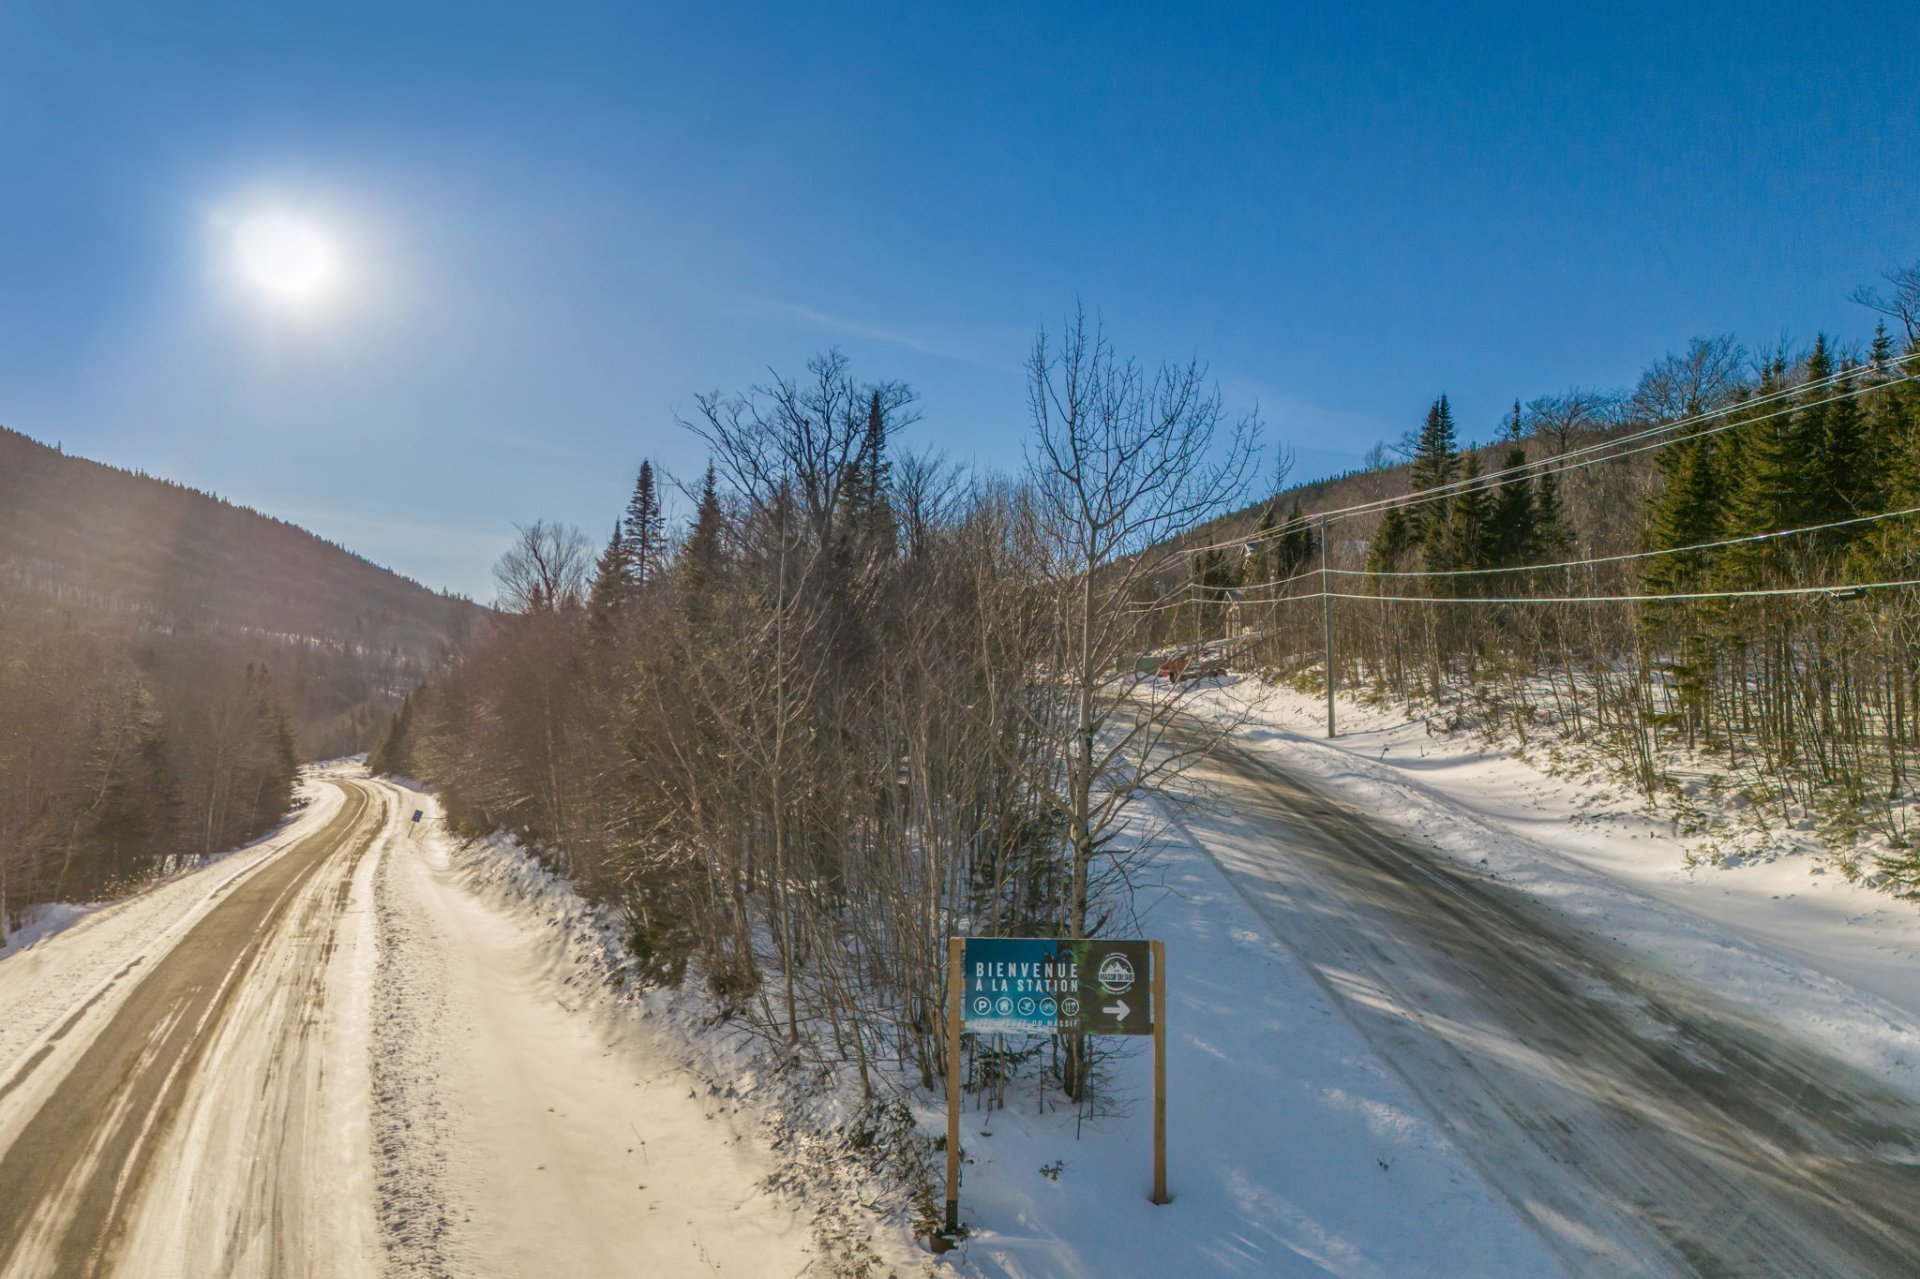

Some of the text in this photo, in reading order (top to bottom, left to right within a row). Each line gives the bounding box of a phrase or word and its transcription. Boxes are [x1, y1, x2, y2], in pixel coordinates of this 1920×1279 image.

[976, 962, 1078, 978] BIENVENUE
[975, 976, 1078, 992] À LA STATION
[1047, 1020, 1078, 1028] MASSIF
